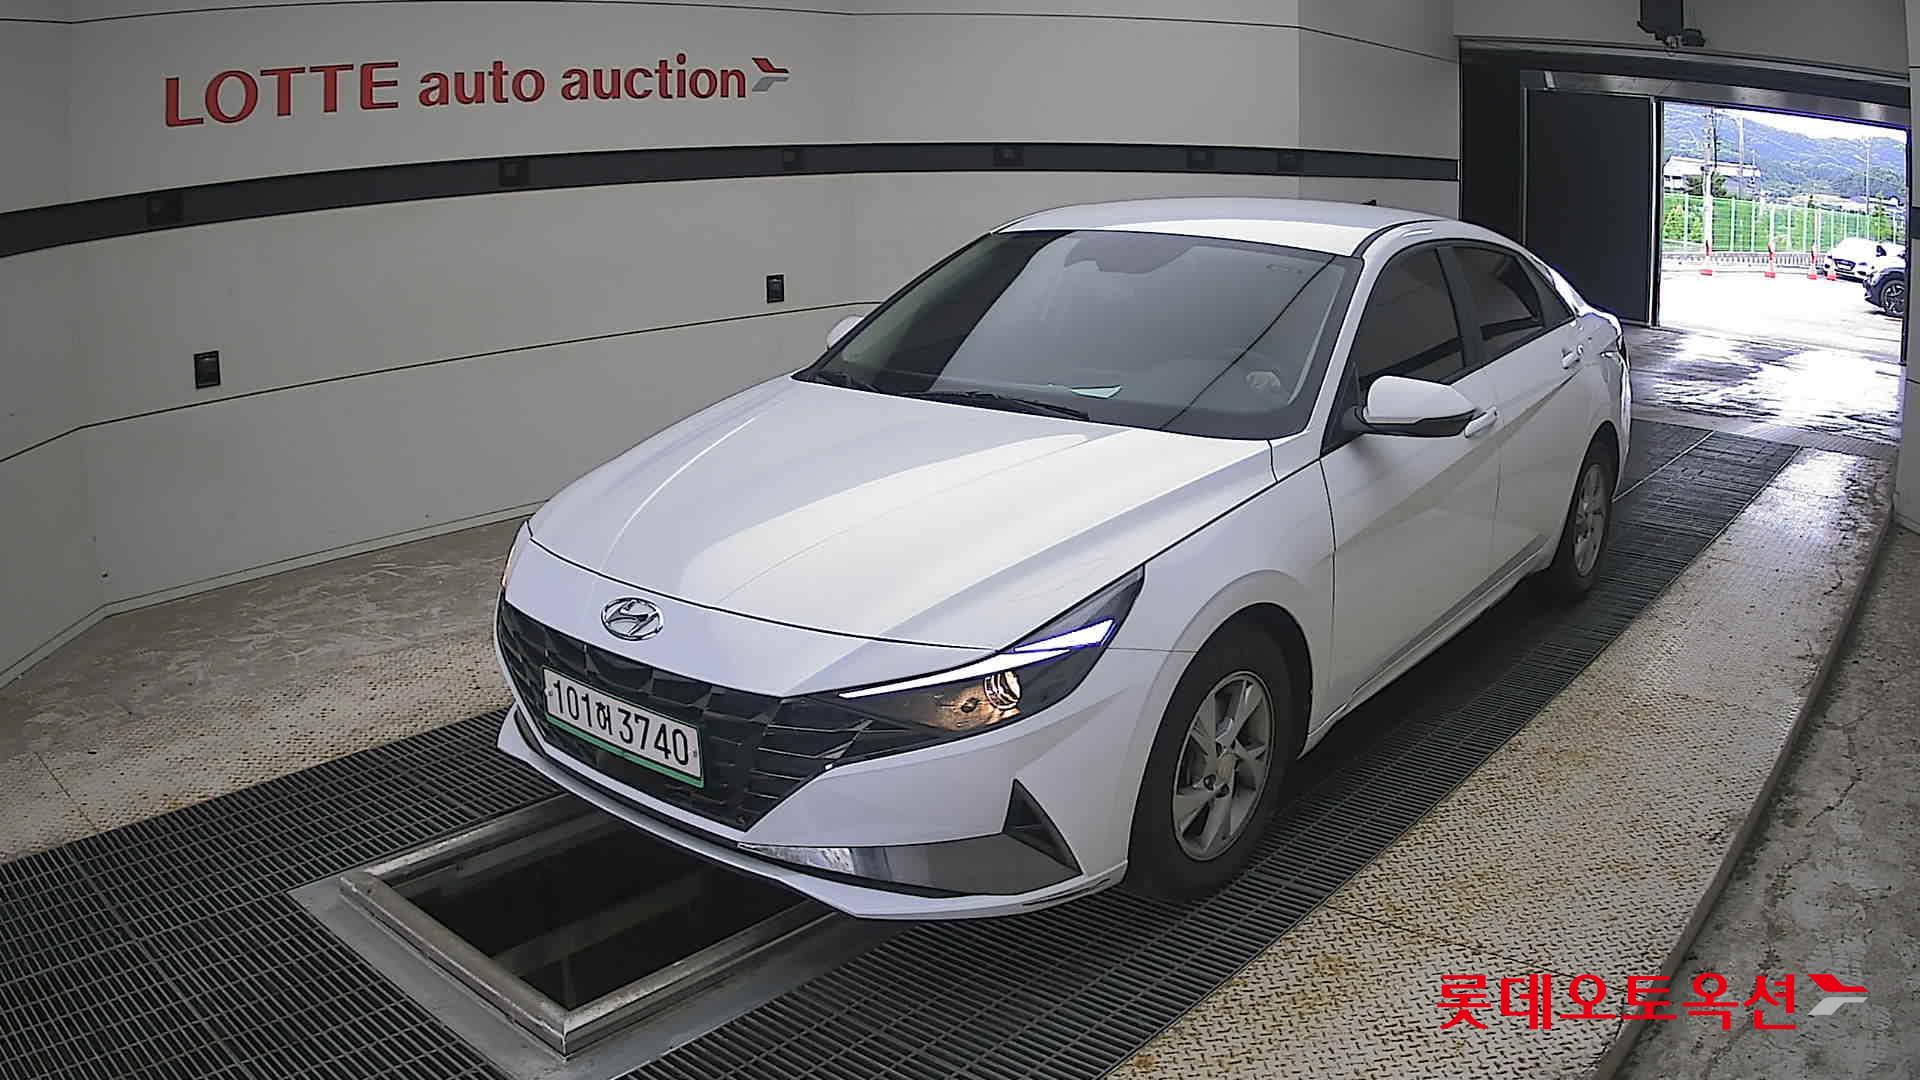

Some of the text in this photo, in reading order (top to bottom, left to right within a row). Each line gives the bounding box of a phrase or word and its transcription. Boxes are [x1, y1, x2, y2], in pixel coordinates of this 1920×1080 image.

[164, 53, 747, 127] LOTTE auto auction
